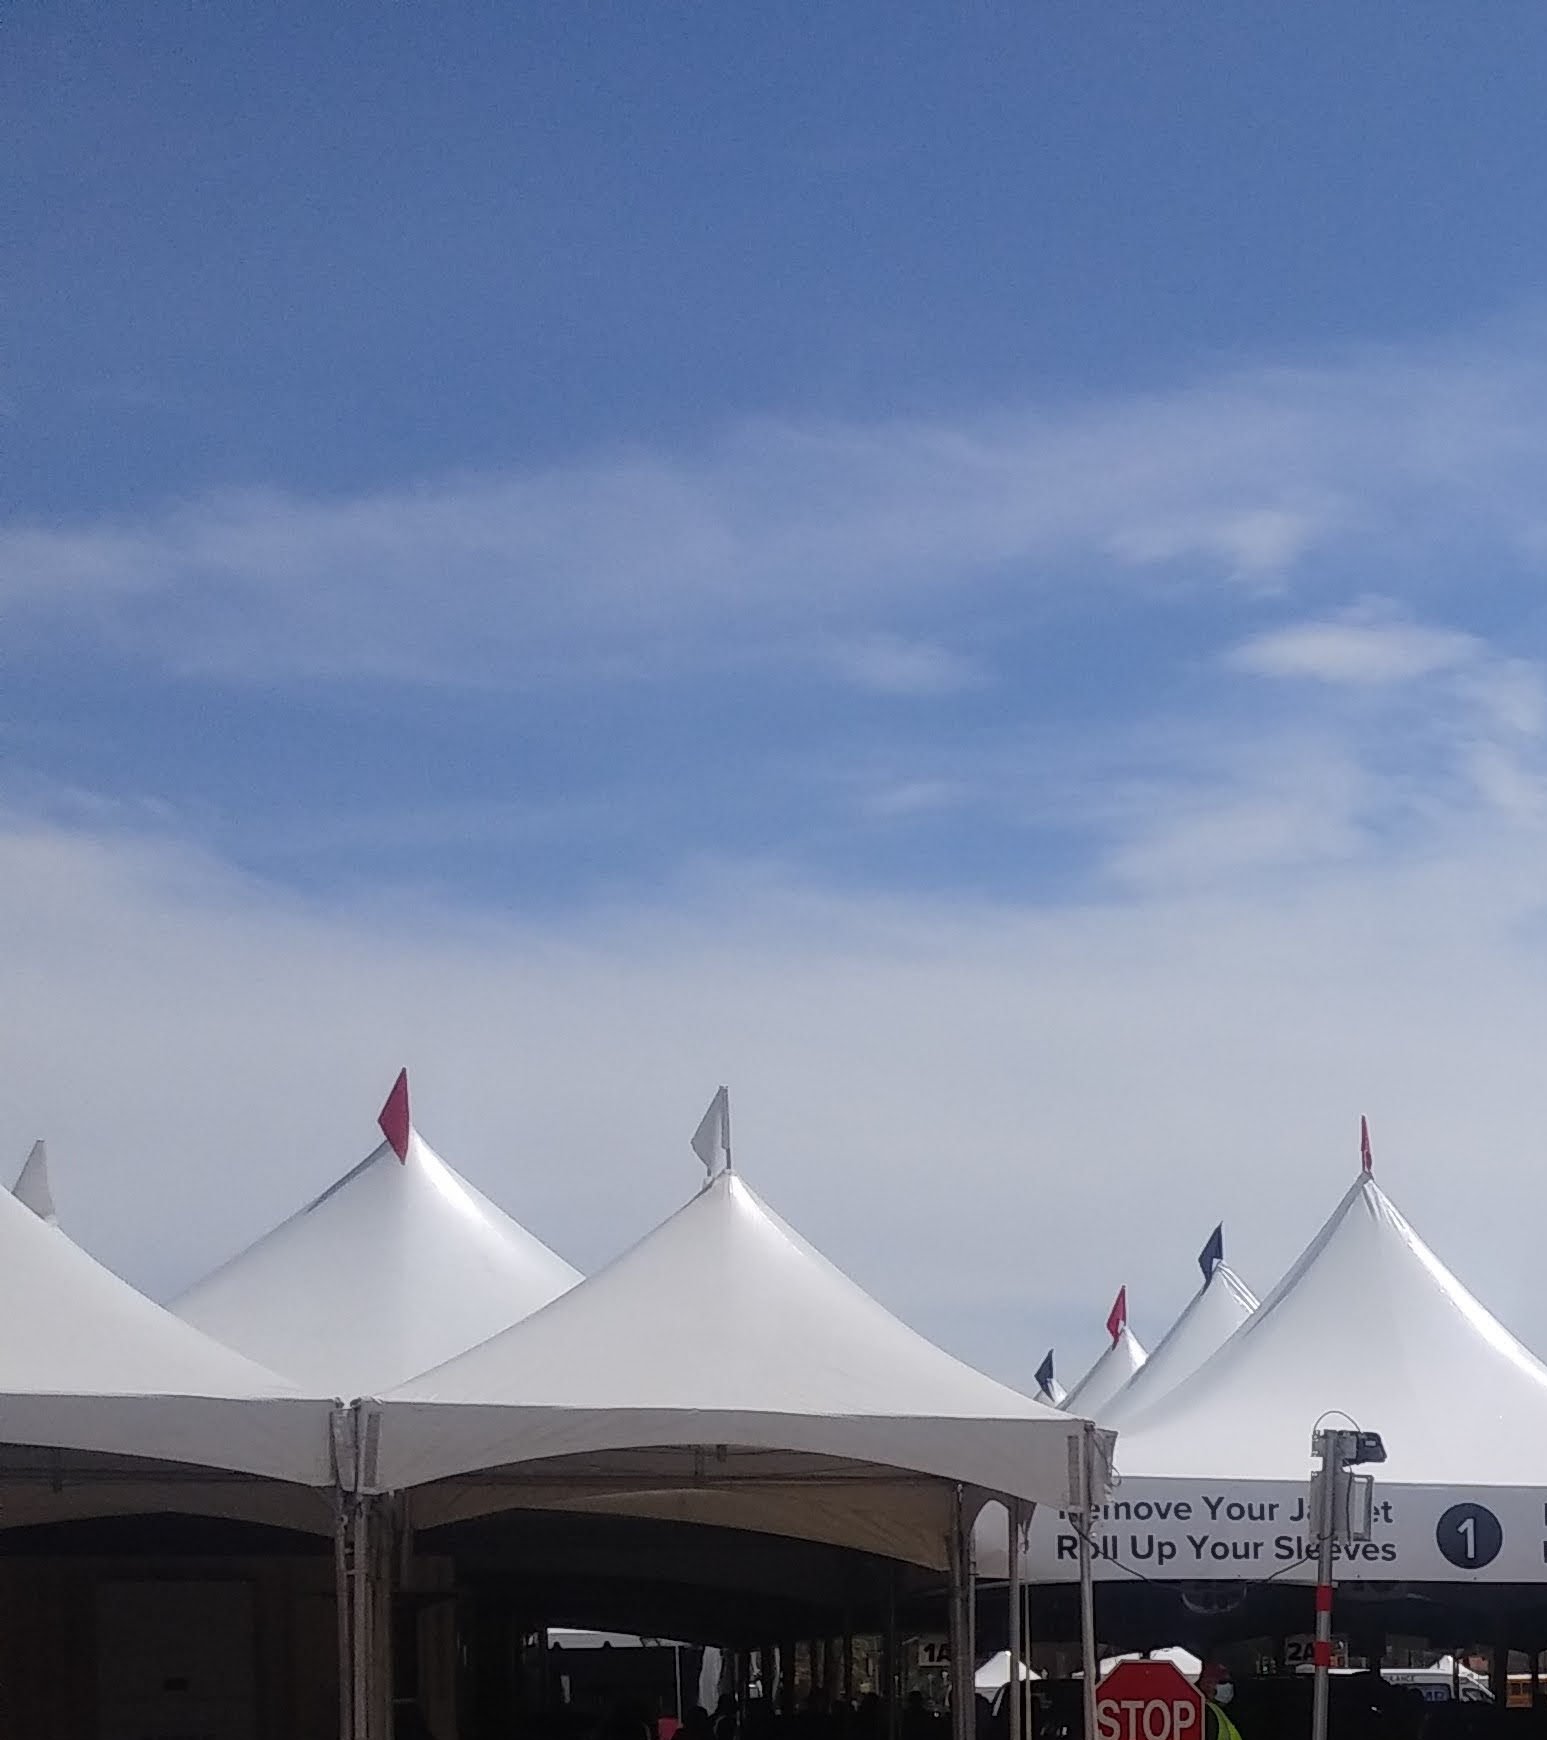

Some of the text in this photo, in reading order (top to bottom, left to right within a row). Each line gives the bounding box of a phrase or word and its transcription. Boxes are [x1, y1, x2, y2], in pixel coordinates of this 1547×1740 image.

[1202, 1496, 1279, 1520] Your
[1131, 1535, 1176, 1565] Up
[1187, 1536, 1263, 1560] Your
[1457, 1518, 1475, 1559] 1
